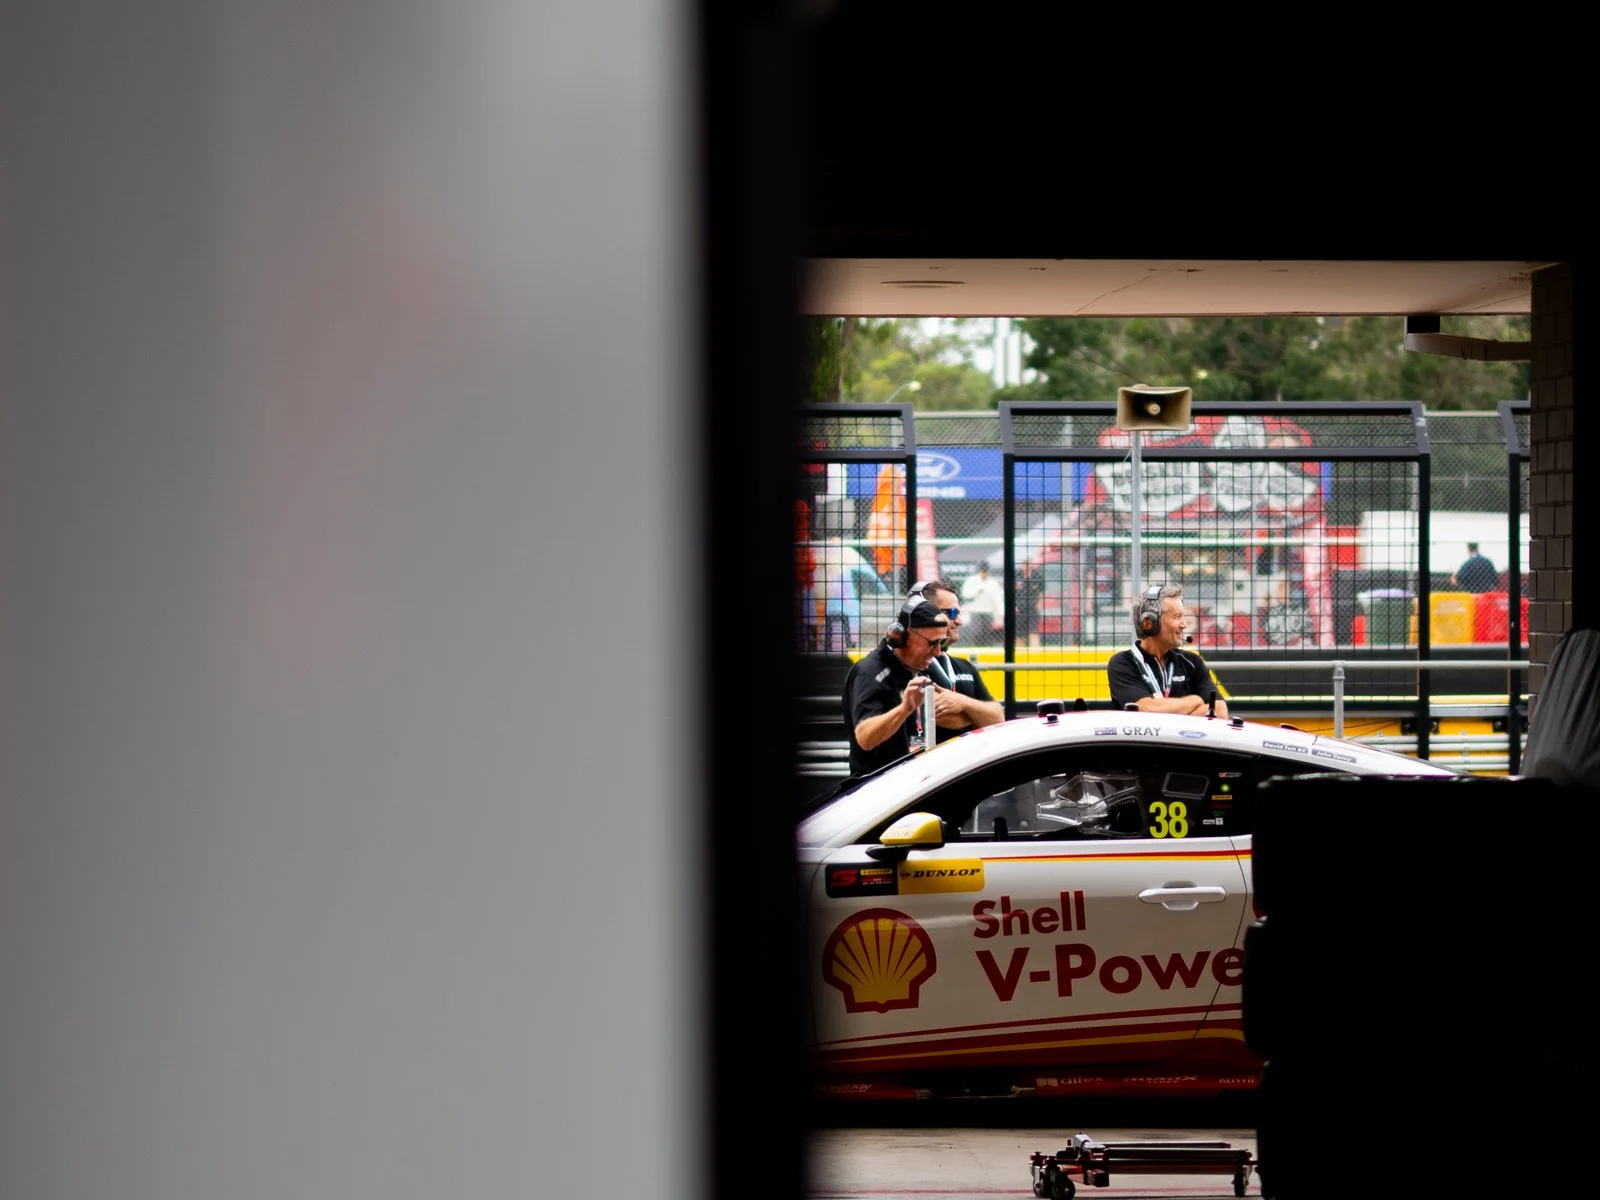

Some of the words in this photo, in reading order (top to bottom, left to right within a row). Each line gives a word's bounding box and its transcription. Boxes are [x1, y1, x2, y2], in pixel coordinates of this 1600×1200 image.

[1122, 727, 1161, 736] GRAY
[1149, 801, 1188, 838] 38
[913, 868, 981, 878] DUNLOP
[973, 890, 1086, 938] Shell
[975, 943, 1244, 1002] V-Powe
